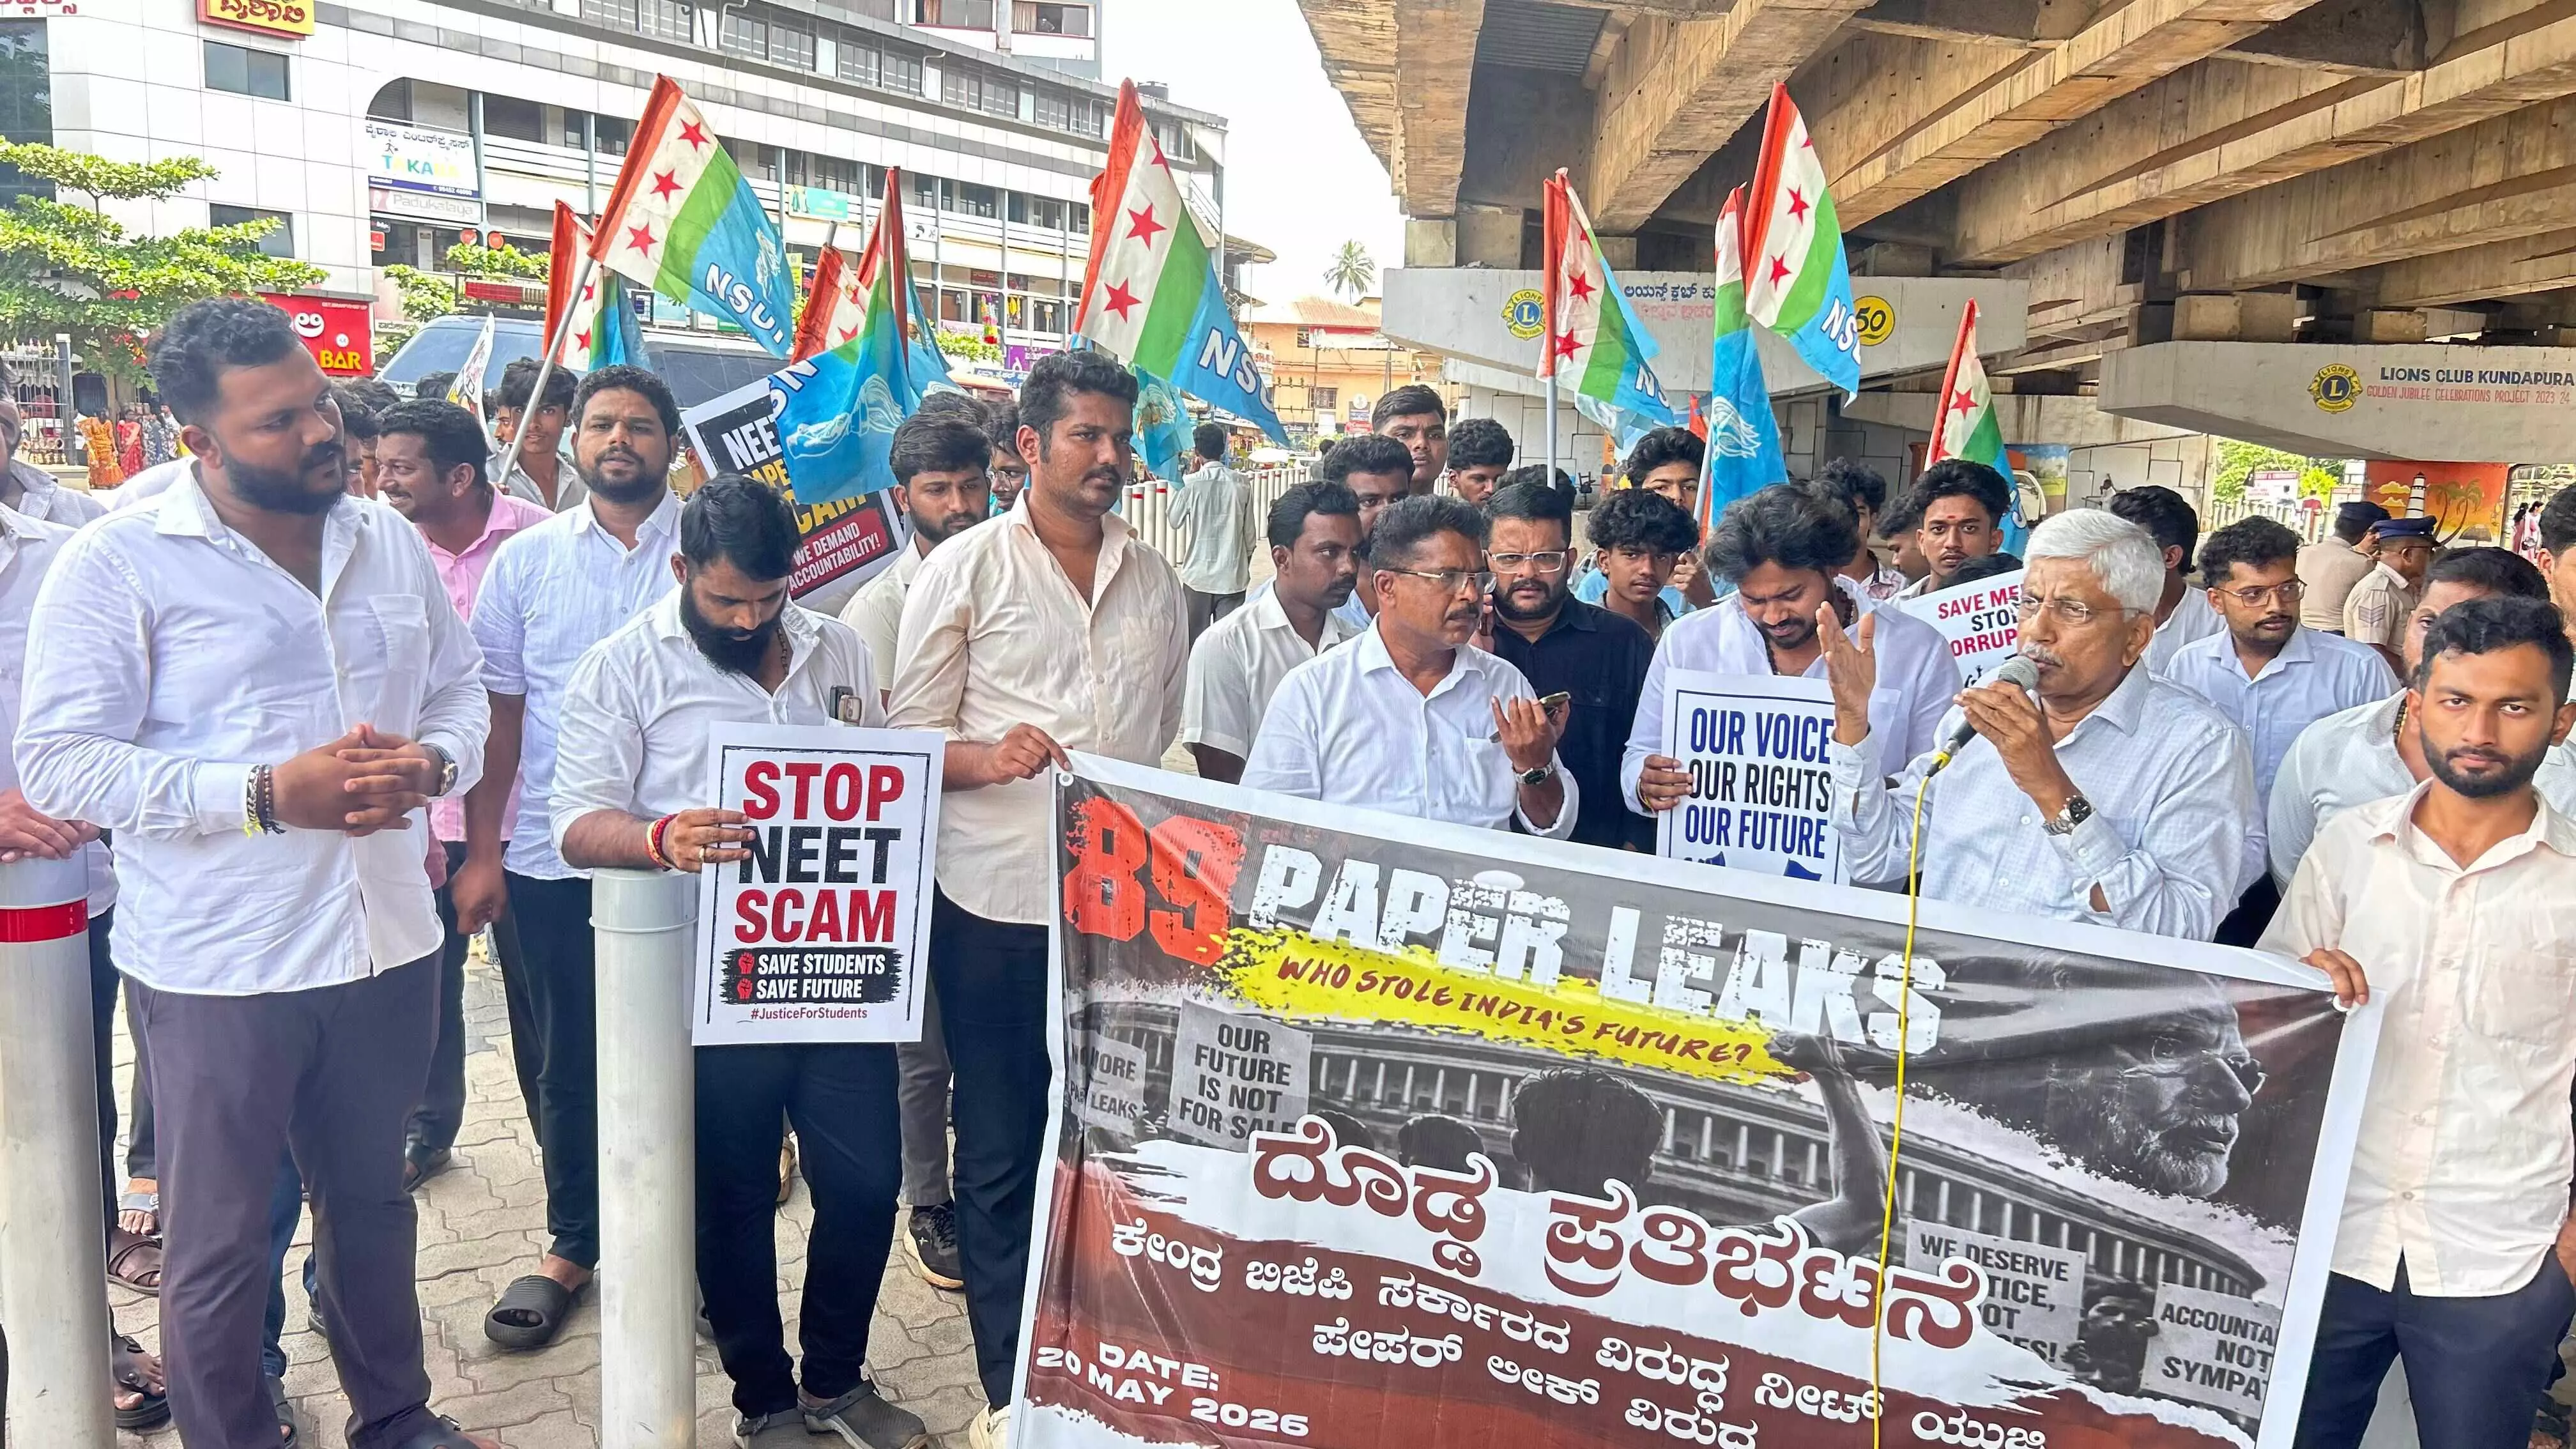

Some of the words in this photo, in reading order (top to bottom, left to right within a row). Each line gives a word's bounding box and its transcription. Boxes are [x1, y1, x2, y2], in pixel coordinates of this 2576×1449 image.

[393, 194, 473, 217] Padukalaya
[705, 263, 785, 346] NSUI
[1521, 304, 1535, 323] L
[1856, 307, 1886, 332] 50
[319, 349, 362, 371] BAR
[2321, 365, 2350, 375] LIONS
[2380, 366, 2430, 382] LIONS
[2435, 369, 2474, 383] CLUB
[2478, 371, 2575, 386] KUNDAPURA
[2329, 379, 2342, 397] L
[2366, 386, 2397, 399] GOLDEN
[2399, 387, 2431, 401] JUBILEE
[2435, 388, 2490, 402] CELEBRATIONS
[2495, 389, 2530, 403] PROJECT
[2535, 390, 2555, 404] 2023
[721, 415, 783, 470] NEE
[788, 532, 882, 592] ACCOUNTABILITY!
[793, 545, 813, 567] WE
[813, 522, 861, 557] DEMAND
[1938, 593, 1986, 620] SAVE
[1950, 628, 2018, 657] ORRUP
[1690, 707, 1745, 756] OUR
[1756, 712, 1834, 764] VOICE
[742, 760, 905, 822] STOP
[1688, 758, 1736, 802] OUR
[1744, 763, 1831, 813] RIGHTS
[1685, 804, 1731, 847] OUR
[1738, 809, 1828, 859] FUTURE
[739, 825, 902, 884] NEET
[734, 888, 898, 943] SCAM
[1063, 795, 1246, 967] 89
[1248, 843, 1571, 987] PAPER
[1598, 905, 1947, 1054] LEAKS
[757, 953, 799, 976] SAVE
[802, 953, 886, 976] STUDENTS
[755, 977, 798, 1000] SAVE
[802, 977, 862, 999] FUTURE
[1277, 954, 1351, 988] WHO
[1355, 969, 1453, 1007] STOLE
[1454, 992, 1586, 1035] INDIA'S
[1591, 1022, 1753, 1064] FUTURE?
[750, 1006, 868, 1021] #JusticeForStudents
[1218, 1023, 1271, 1054] OUR
[1194, 1043, 1292, 1086] FUTURE
[1091, 1092, 1138, 1119] LEAKS
[1179, 1096, 1223, 1133] FOR
[1198, 1073, 1221, 1101] IS
[1228, 1084, 1283, 1114] NOT
[1252, 1120, 1494, 1278] ದೊಡ್ಡ
[1544, 1182, 1981, 1350] ಪ್ರತಿಭಟನೆ
[1920, 1232, 1958, 1258] WE
[1965, 1243, 2069, 1282] DESERVE
[1988, 1274, 2056, 1312] TICE,
[1110, 1216, 1224, 1292] ಕೇಂದ್ರ
[1245, 1255, 1354, 1301] ಬಿಜೆಪಿ
[1377, 1271, 1572, 1355] ಸರ್ಕಾರದ
[1596, 1336, 1729, 1414] ವಿರುದ್ಧ
[1754, 1371, 1886, 1424] ನೀಟ್
[1979, 1303, 2021, 1330] OT
[2160, 1303, 2279, 1347] ACCOUNTA
[1098, 1341, 1221, 1392] DATE:
[1312, 1316, 1464, 1369] ಪೇಪರ್
[1487, 1354, 1601, 1407] ಲೀಕ್
[2215, 1338, 2274, 1374] NOT
[1036, 1346, 1082, 1377] 20
[1087, 1363, 1175, 1407] MAY
[1190, 1397, 1310, 1438] 2026
[2161, 1355, 2269, 1401] SYMPA
